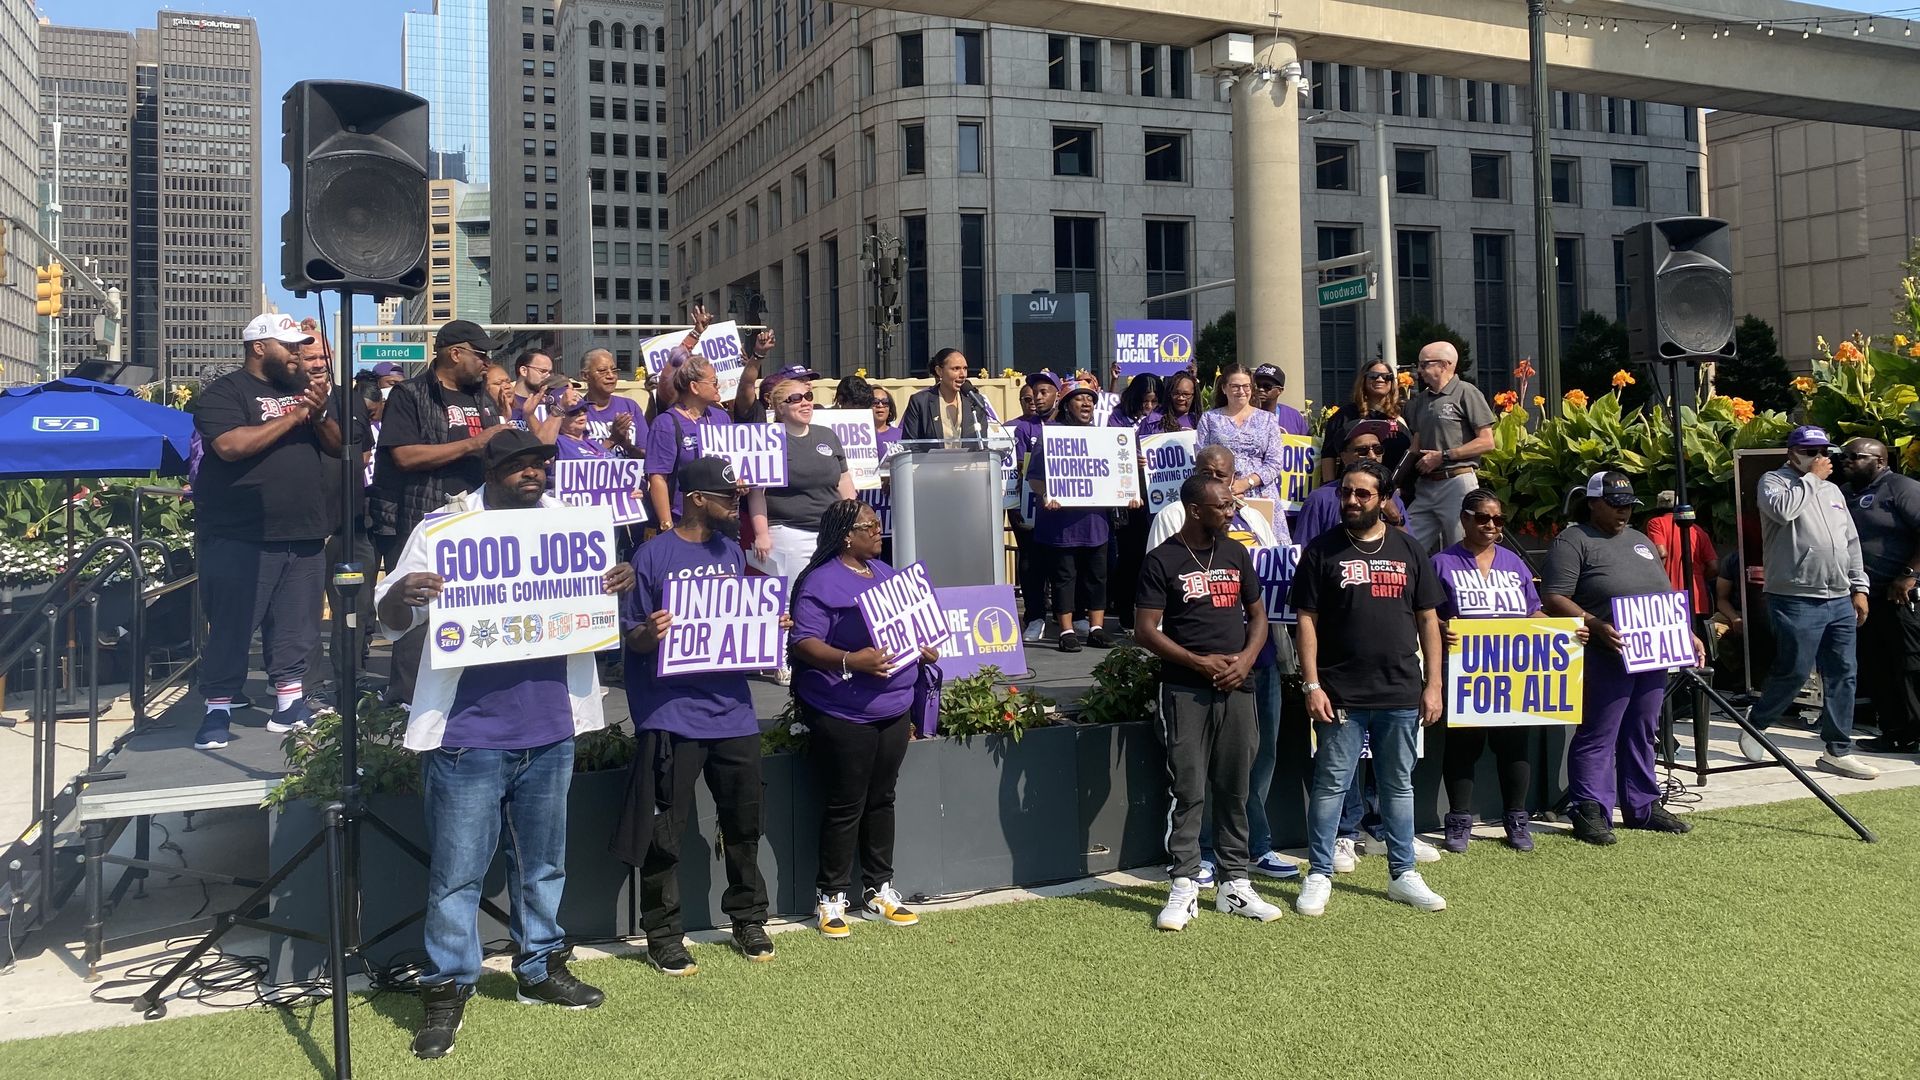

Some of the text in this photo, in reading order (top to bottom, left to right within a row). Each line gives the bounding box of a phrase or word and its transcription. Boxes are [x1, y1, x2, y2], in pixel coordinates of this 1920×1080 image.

[1323, 282, 1363, 301] Woodward
[1029, 297, 1058, 314] ally
[376, 348, 410, 357] Larned
[1117, 334, 1158, 348] WE ARE
[650, 347, 672, 374] GO
[1117, 349, 1159, 363] LOCAL 1
[700, 424, 782, 453] UNIONS
[1047, 437, 1089, 456] ARENA
[844, 447, 878, 459] UNITIES
[1146, 445, 1186, 471] GOOD
[1283, 445, 1315, 474] ONS
[561, 461, 639, 491] UNIONS
[740, 455, 781, 483] ALL
[1047, 458, 1110, 478] WORKERS
[1117, 463, 1133, 474] 58
[1147, 470, 1181, 484] THRIVING
[1048, 478, 1094, 498] UNITED
[600, 491, 642, 521] ALL
[436, 531, 607, 583] GOOD JOBS
[1250, 547, 1298, 581] IONS
[437, 576, 606, 609] THRIVING COMMUNITIE
[1371, 584, 1403, 598] GRIT!
[1451, 568, 1522, 590] UNIONS
[670, 577, 781, 619] UNIONS
[860, 563, 931, 625] UNIONS
[1260, 585, 1298, 619] LL
[1459, 589, 1526, 613] FOR ALL
[1616, 594, 1687, 631] UNIONS
[502, 613, 544, 646] 58
[877, 620, 911, 655] FOR
[911, 603, 946, 647] ALL
[668, 622, 774, 664] FOR ALL
[964, 633, 975, 656] 1
[978, 644, 1018, 654] DETROIT
[1462, 633, 1570, 674] UNIONS
[1623, 626, 1692, 664] FOR ALL
[1457, 675, 1574, 714] FOR ALL
